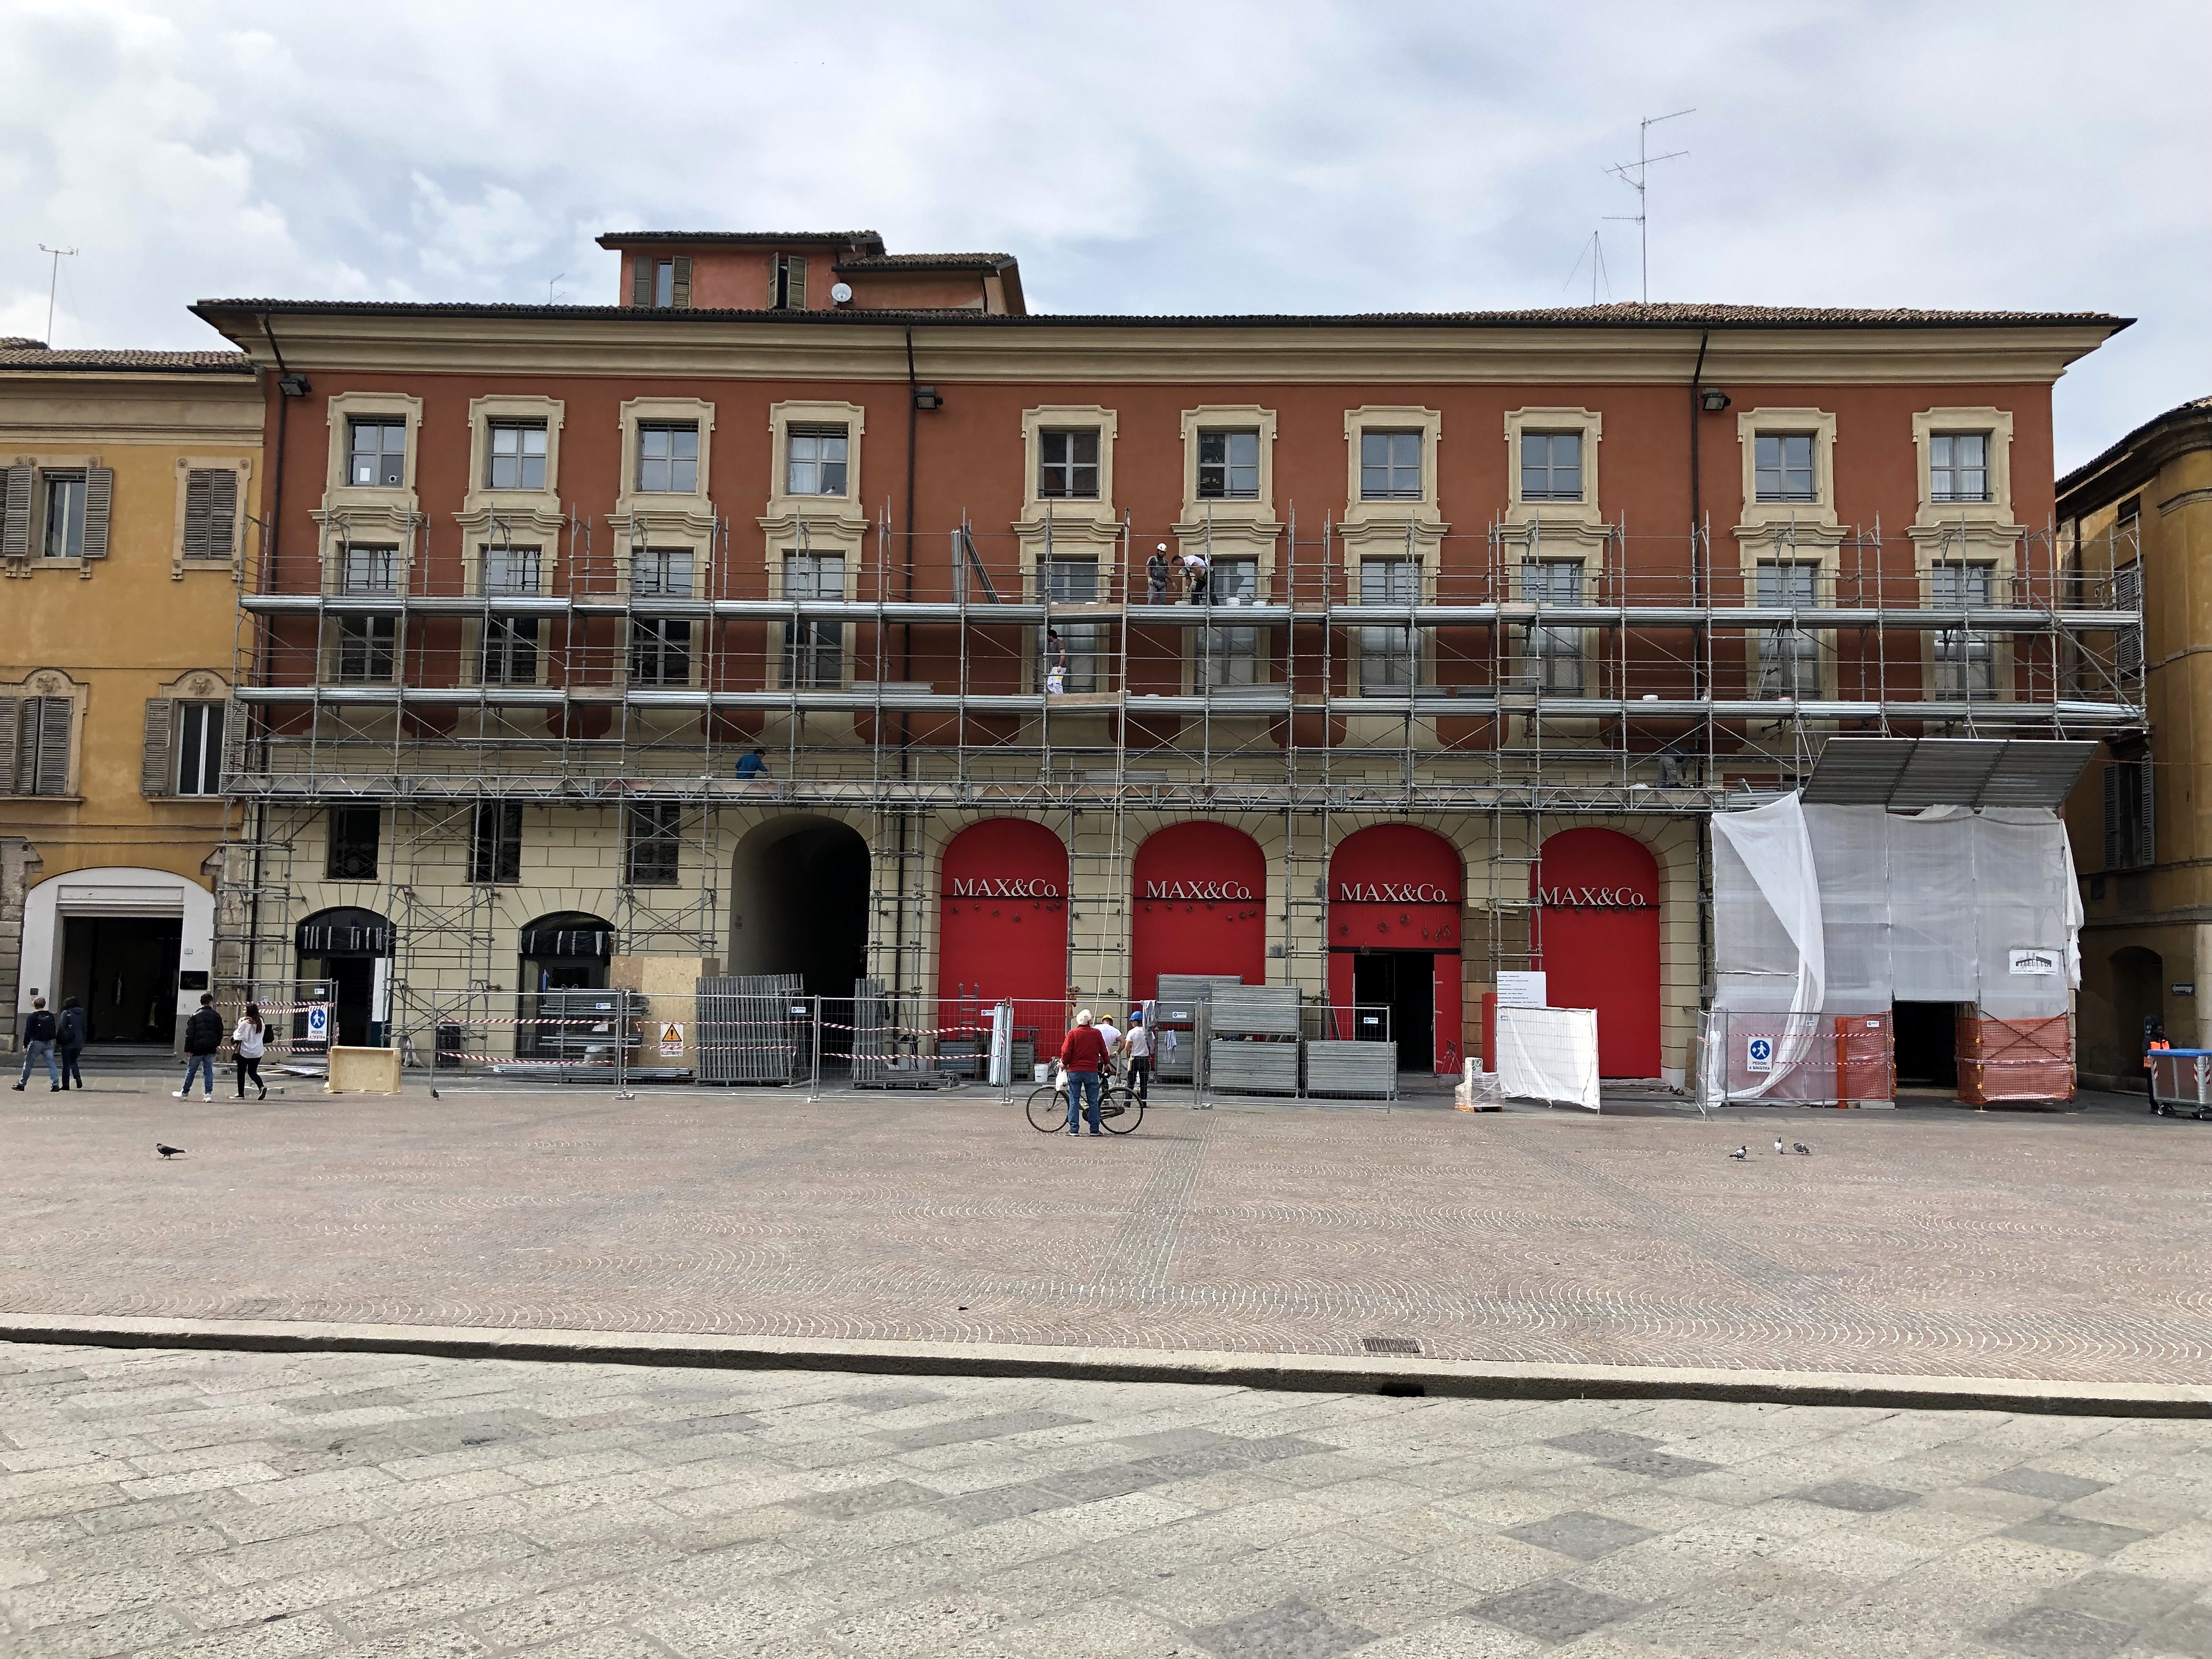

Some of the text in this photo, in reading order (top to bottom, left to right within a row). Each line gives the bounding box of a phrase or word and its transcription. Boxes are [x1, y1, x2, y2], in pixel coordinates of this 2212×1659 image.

[952, 878, 1059, 897] MAX&Co.
[1146, 880, 1252, 899] MAX&Co.
[1340, 883, 1448, 902] MAX&Co.
[1539, 887, 1646, 906] MAX&Co.
